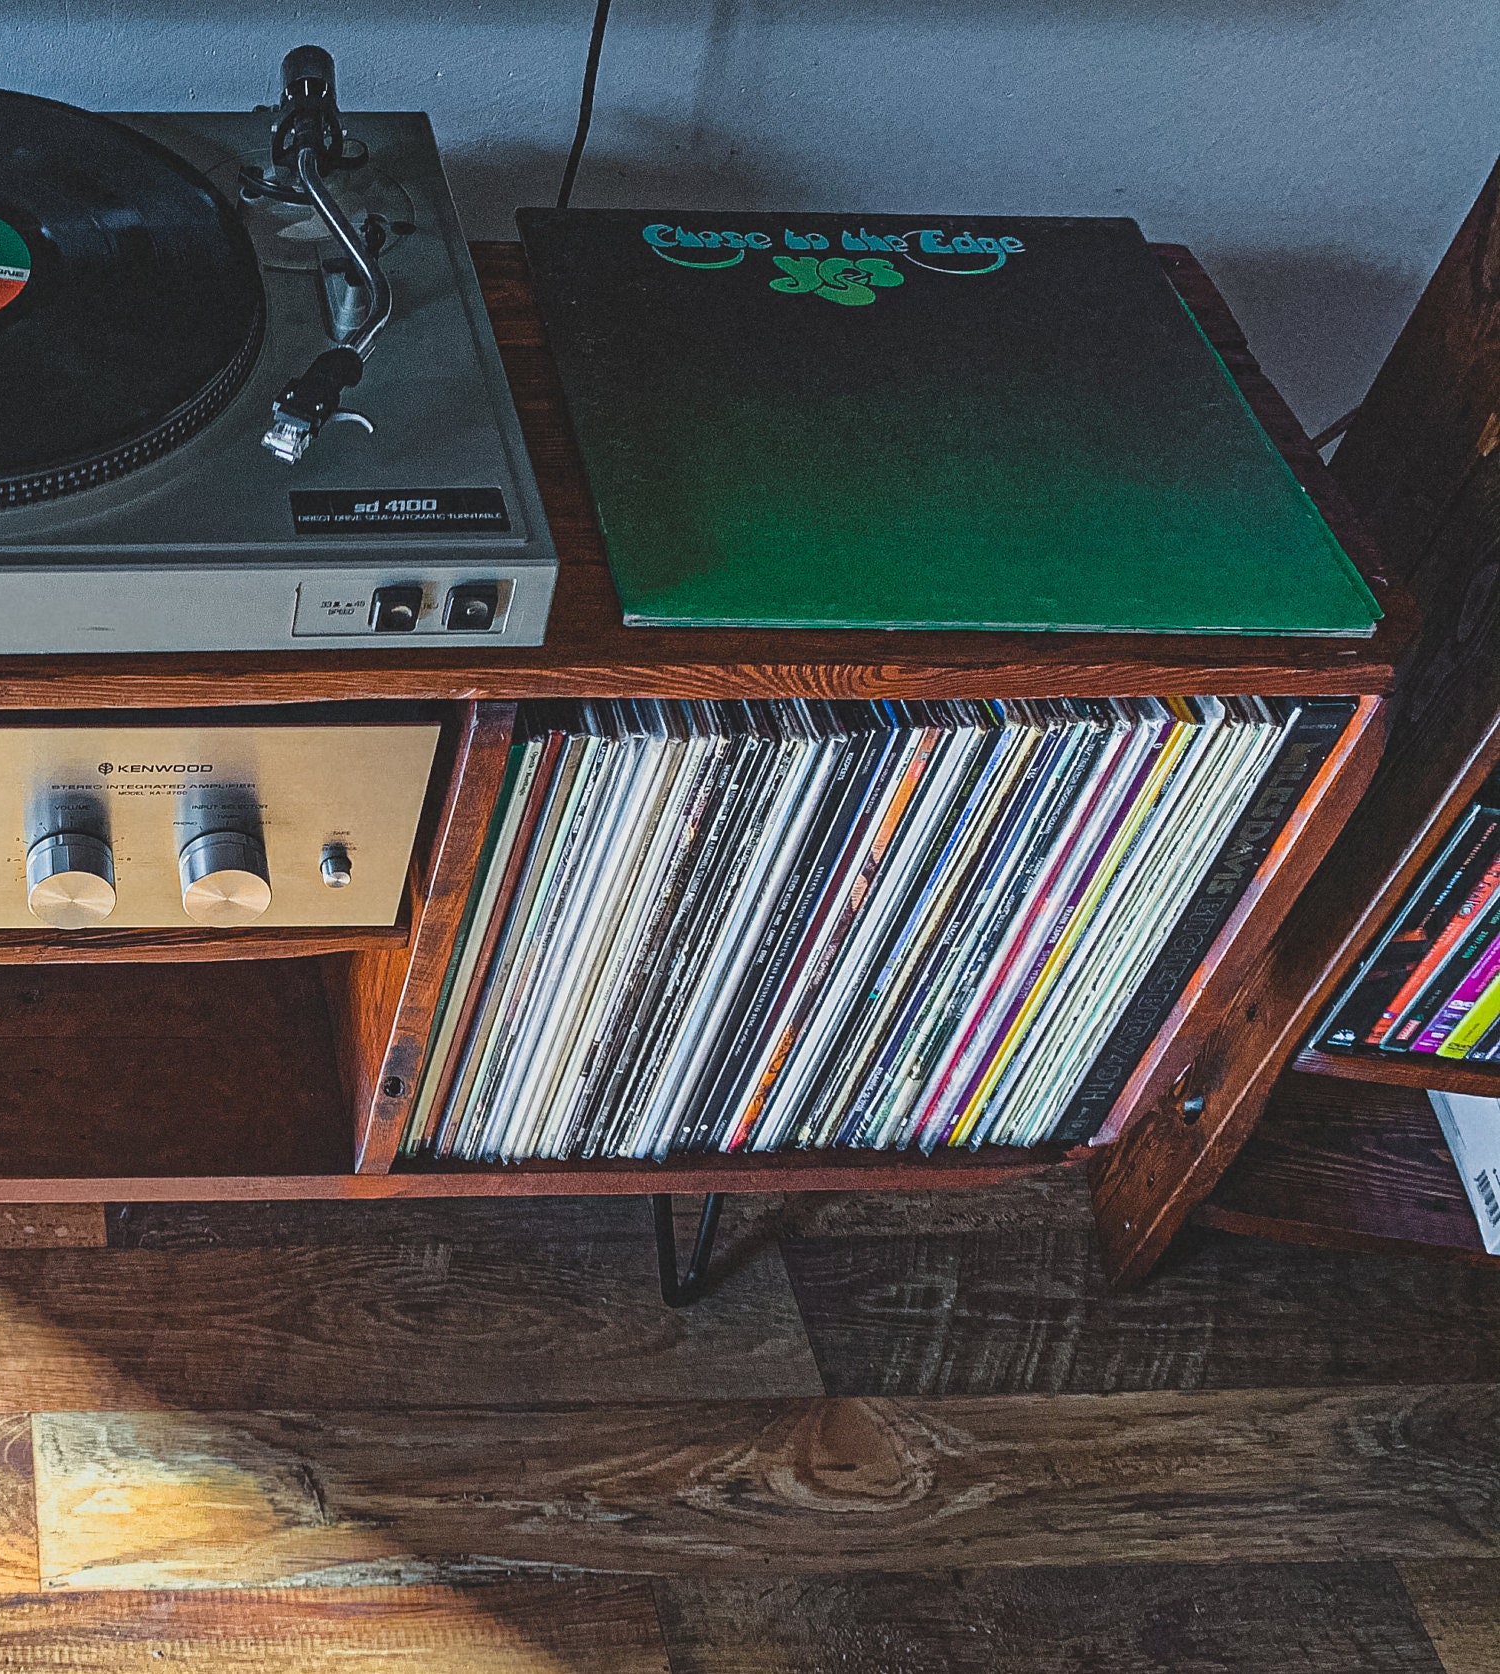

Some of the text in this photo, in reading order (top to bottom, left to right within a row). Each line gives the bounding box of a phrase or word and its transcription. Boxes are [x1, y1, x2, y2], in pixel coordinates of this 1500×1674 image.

[784, 227, 830, 250] to
[842, 227, 909, 252] the
[353, 499, 438, 513] sd 4100
[117, 764, 213, 773] KENWOOD
[715, 764, 732, 789] MERCURY
[1024, 766, 1039, 780] YES
[1246, 741, 1326, 819] MILES
[1200, 820, 1277, 895] DAVIS
[806, 865, 825, 892] STEVEN
[794, 893, 813, 919] WILSON
[1055, 904, 1076, 925] FRANK
[786, 921, 800, 936] THE
[1045, 925, 1064, 944] ZAPPA
[1142, 897, 1230, 991] BITCHES
[769, 957, 783, 974] THAT
[751, 1003, 762, 1012] TO
